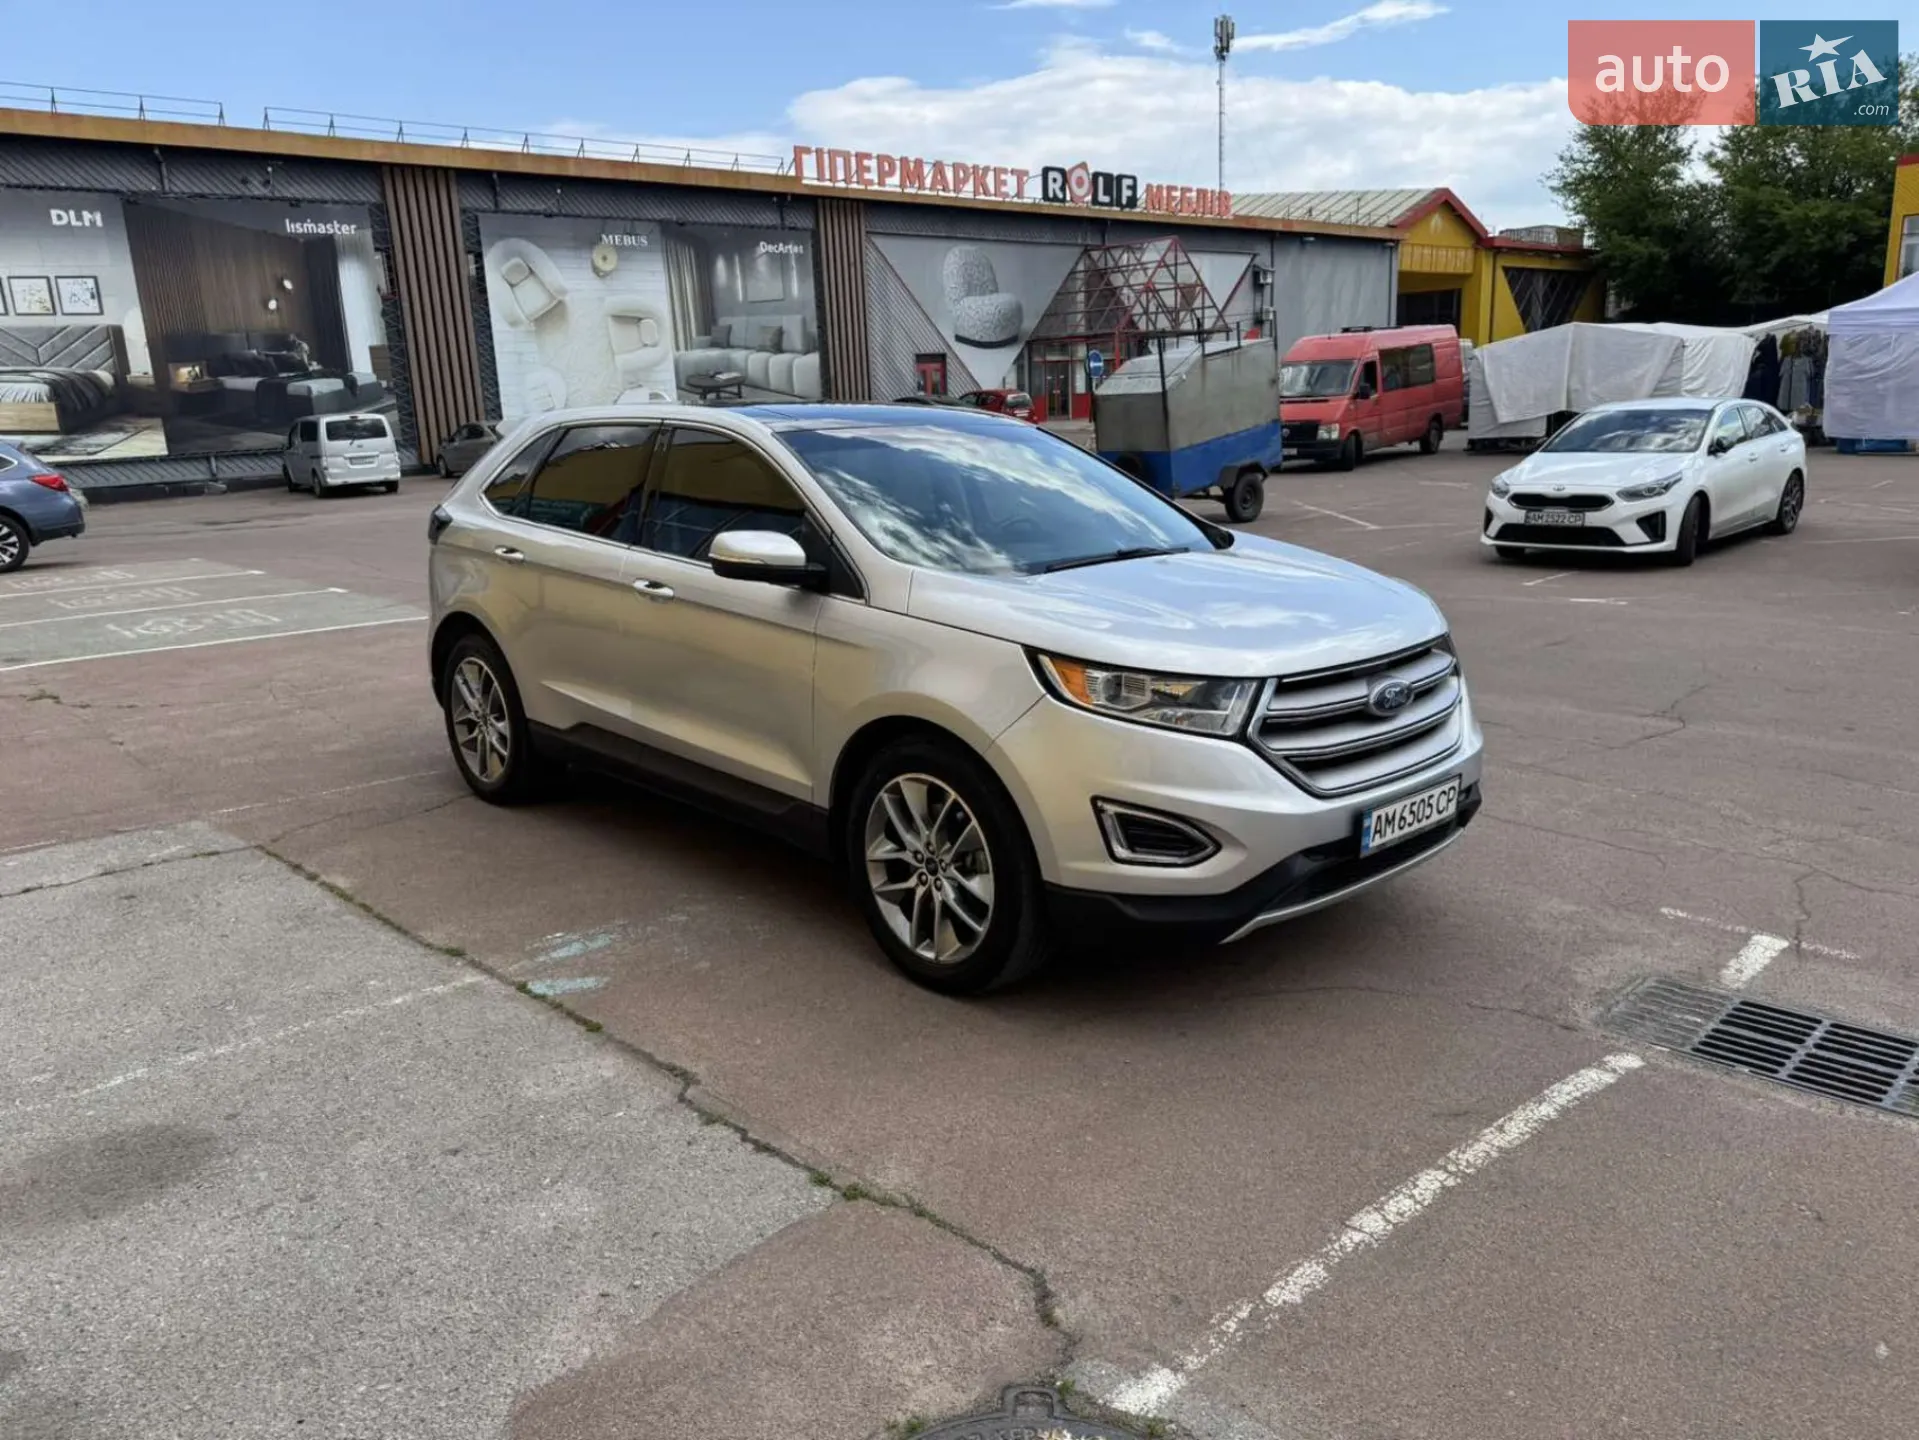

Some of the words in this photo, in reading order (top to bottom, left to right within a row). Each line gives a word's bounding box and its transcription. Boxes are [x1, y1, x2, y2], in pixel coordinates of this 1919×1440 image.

[793, 145, 1029, 200] ГІПЕРМАРКЕТ
[1044, 163, 1136, 208] ROLF
[49, 208, 103, 228] DLM
[1145, 183, 1232, 217] МЕБЛІВ
[601, 233, 649, 247] MEBUS
[1371, 809, 1396, 843] AM
[1397, 794, 1434, 830] 6505
[1435, 785, 1457, 816] CP
